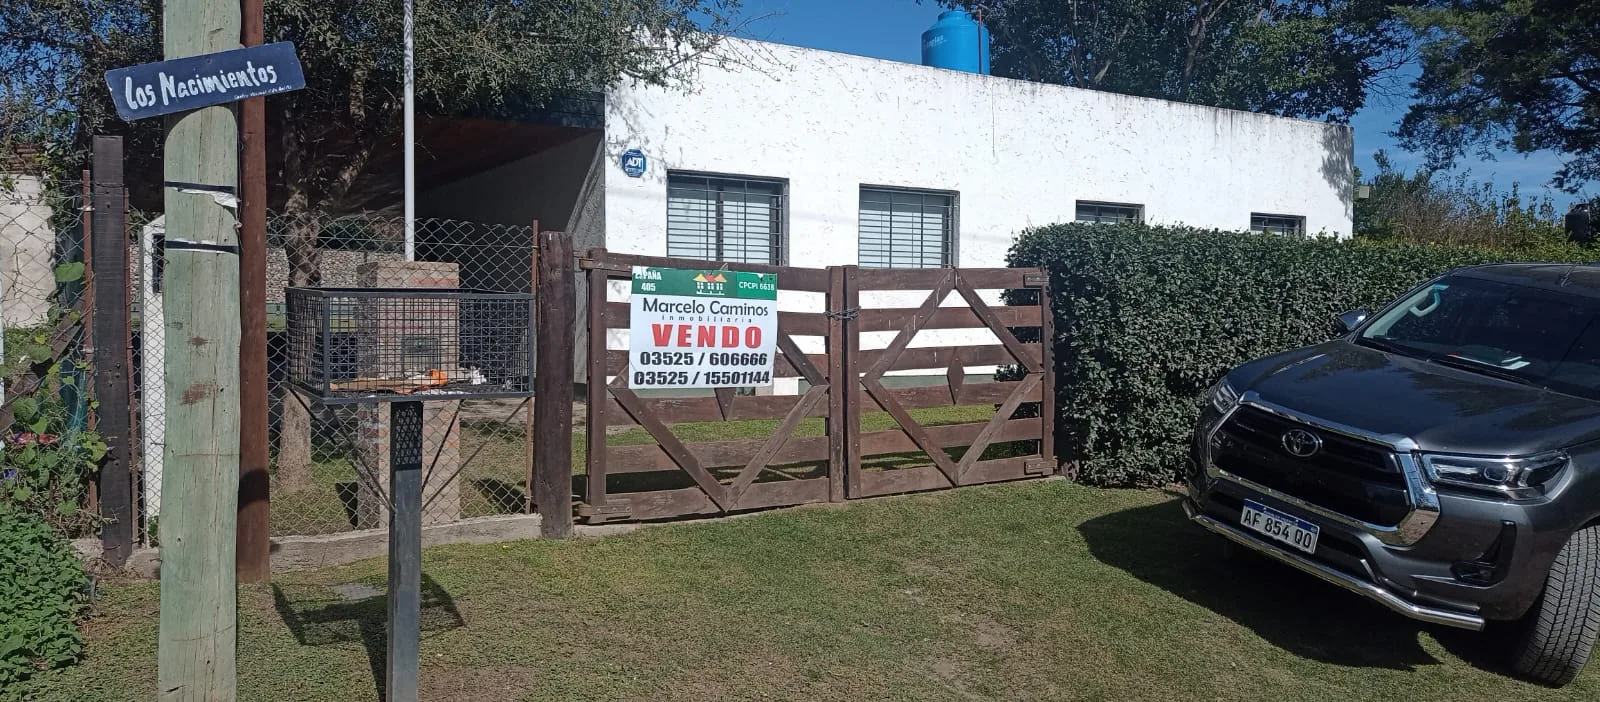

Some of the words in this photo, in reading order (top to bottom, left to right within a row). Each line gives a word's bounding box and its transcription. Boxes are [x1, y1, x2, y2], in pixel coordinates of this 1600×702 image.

[125, 76, 156, 110] Los
[158, 60, 278, 106] Nacimientos
[625, 157, 643, 168] ADT
[641, 282, 656, 292] 405
[760, 282, 775, 291] 6638
[642, 297, 705, 314] Marcelo
[709, 300, 768, 316] Caminos
[662, 314, 752, 323] inmobiliaria
[651, 323, 762, 349] VENDO
[640, 351, 694, 366] 03525
[698, 352, 705, 366] /
[709, 352, 768, 366] 606666
[634, 371, 689, 385] 03525
[692, 371, 700, 385] /
[704, 370, 770, 385] 15501144
[1244, 509, 1262, 526] AF
[1264, 517, 1290, 540] 854
